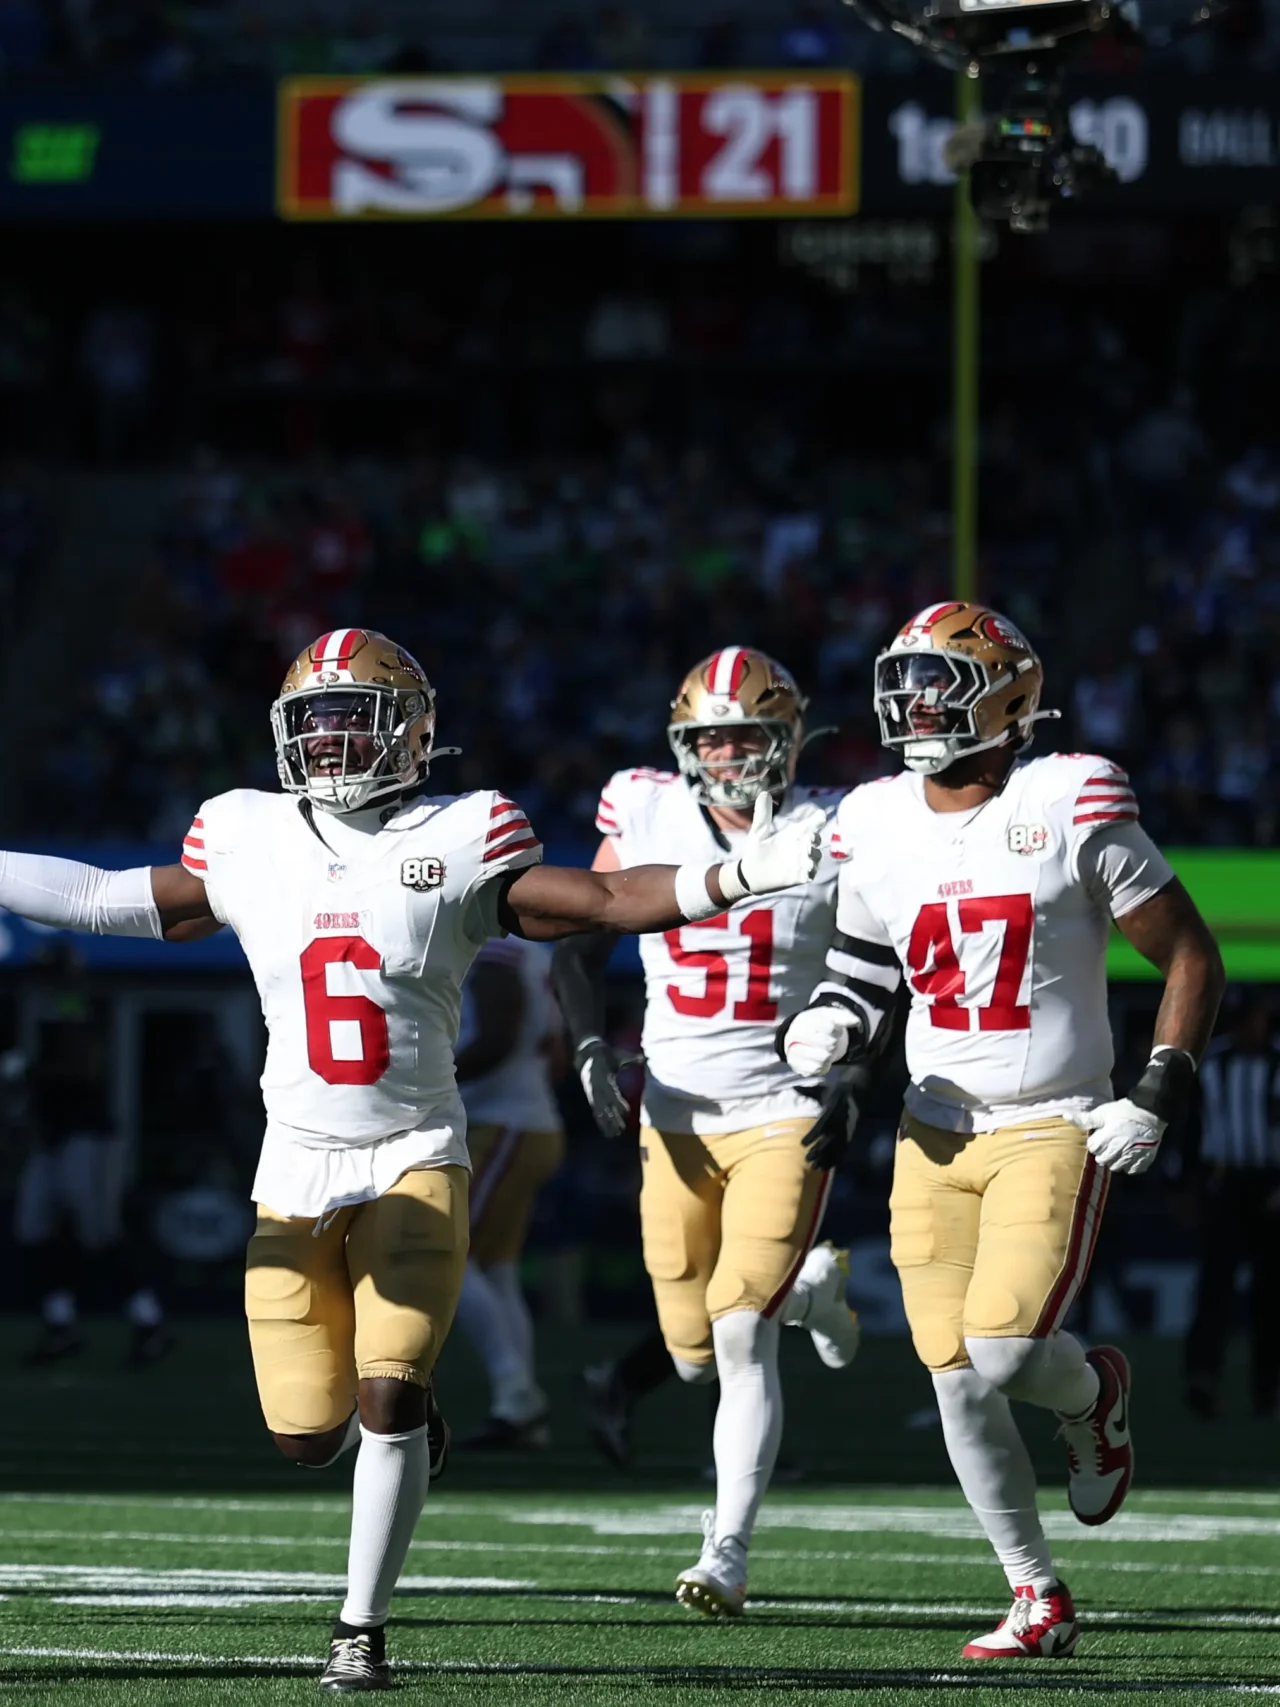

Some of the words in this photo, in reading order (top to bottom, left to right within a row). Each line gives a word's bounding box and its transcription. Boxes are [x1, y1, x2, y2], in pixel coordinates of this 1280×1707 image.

[700, 82, 822, 204] 21
[1178, 107, 1273, 166] BALL
[313, 911, 360, 929] 49ERS
[937, 879, 974, 898] 49ERS
[299, 936, 390, 1086] 6
[663, 909, 779, 1022] 51
[907, 893, 1035, 1033] 47
